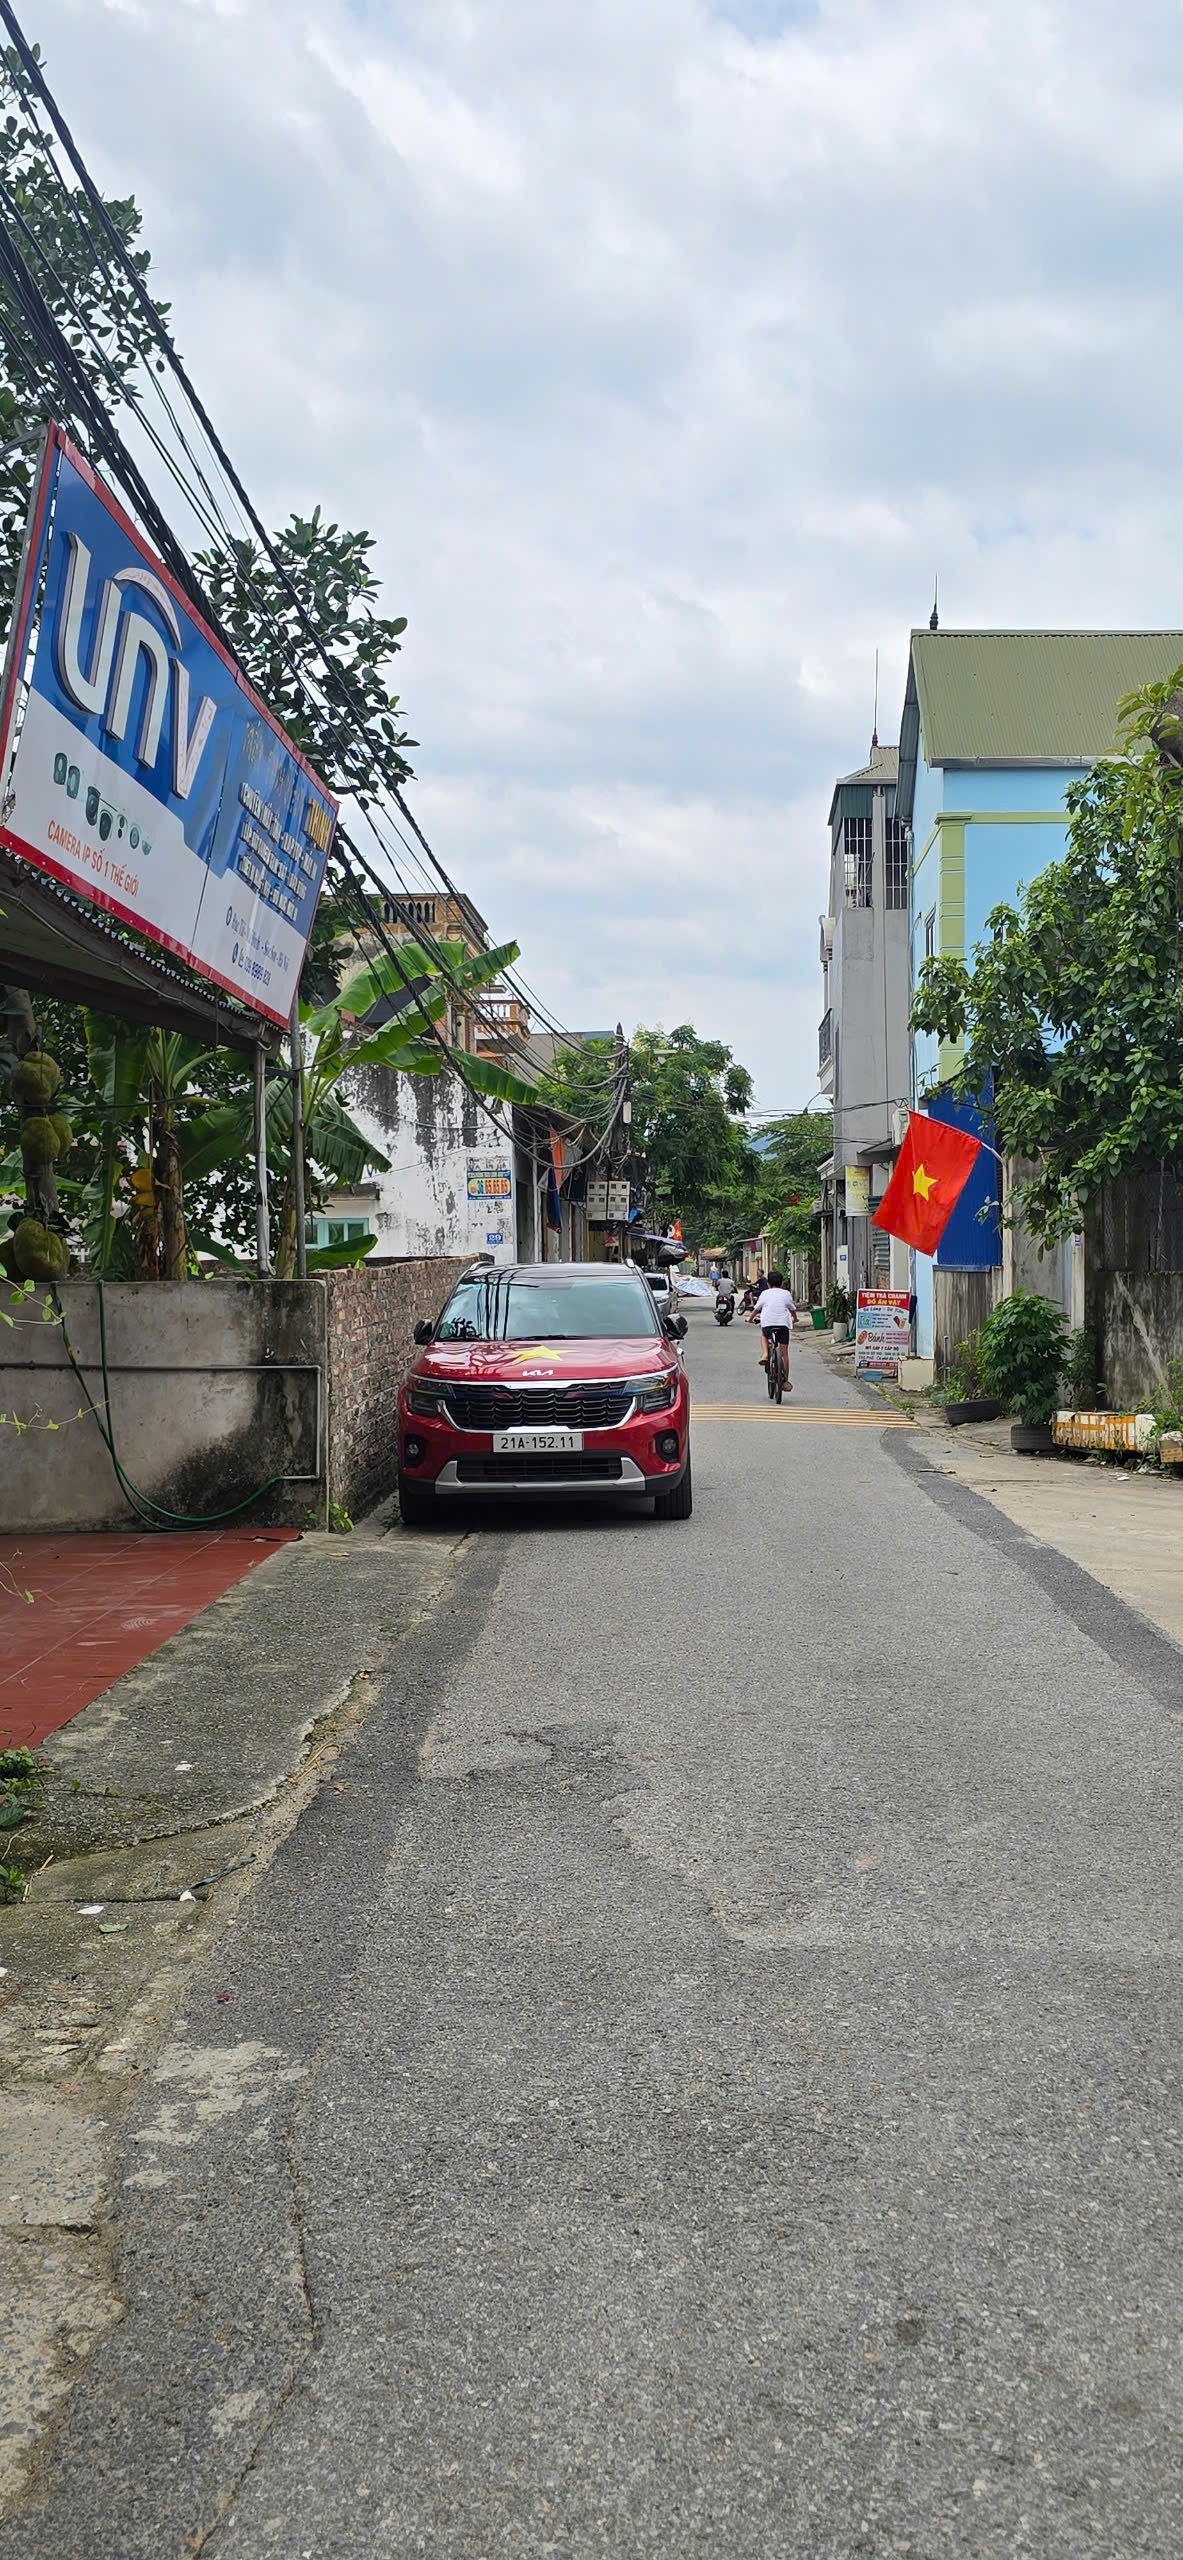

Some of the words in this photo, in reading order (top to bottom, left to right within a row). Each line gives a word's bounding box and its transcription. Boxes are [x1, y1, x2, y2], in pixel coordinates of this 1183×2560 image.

[47, 820, 80, 860] CAMERA
[82, 844, 91, 864] IP
[91, 848, 105, 872] SỐ
[104, 861, 109, 877] 1
[110, 864, 127, 887] THẾ
[124, 874, 140, 897] GIỚI
[501, 1436, 574, 1449] 21A-152.11
